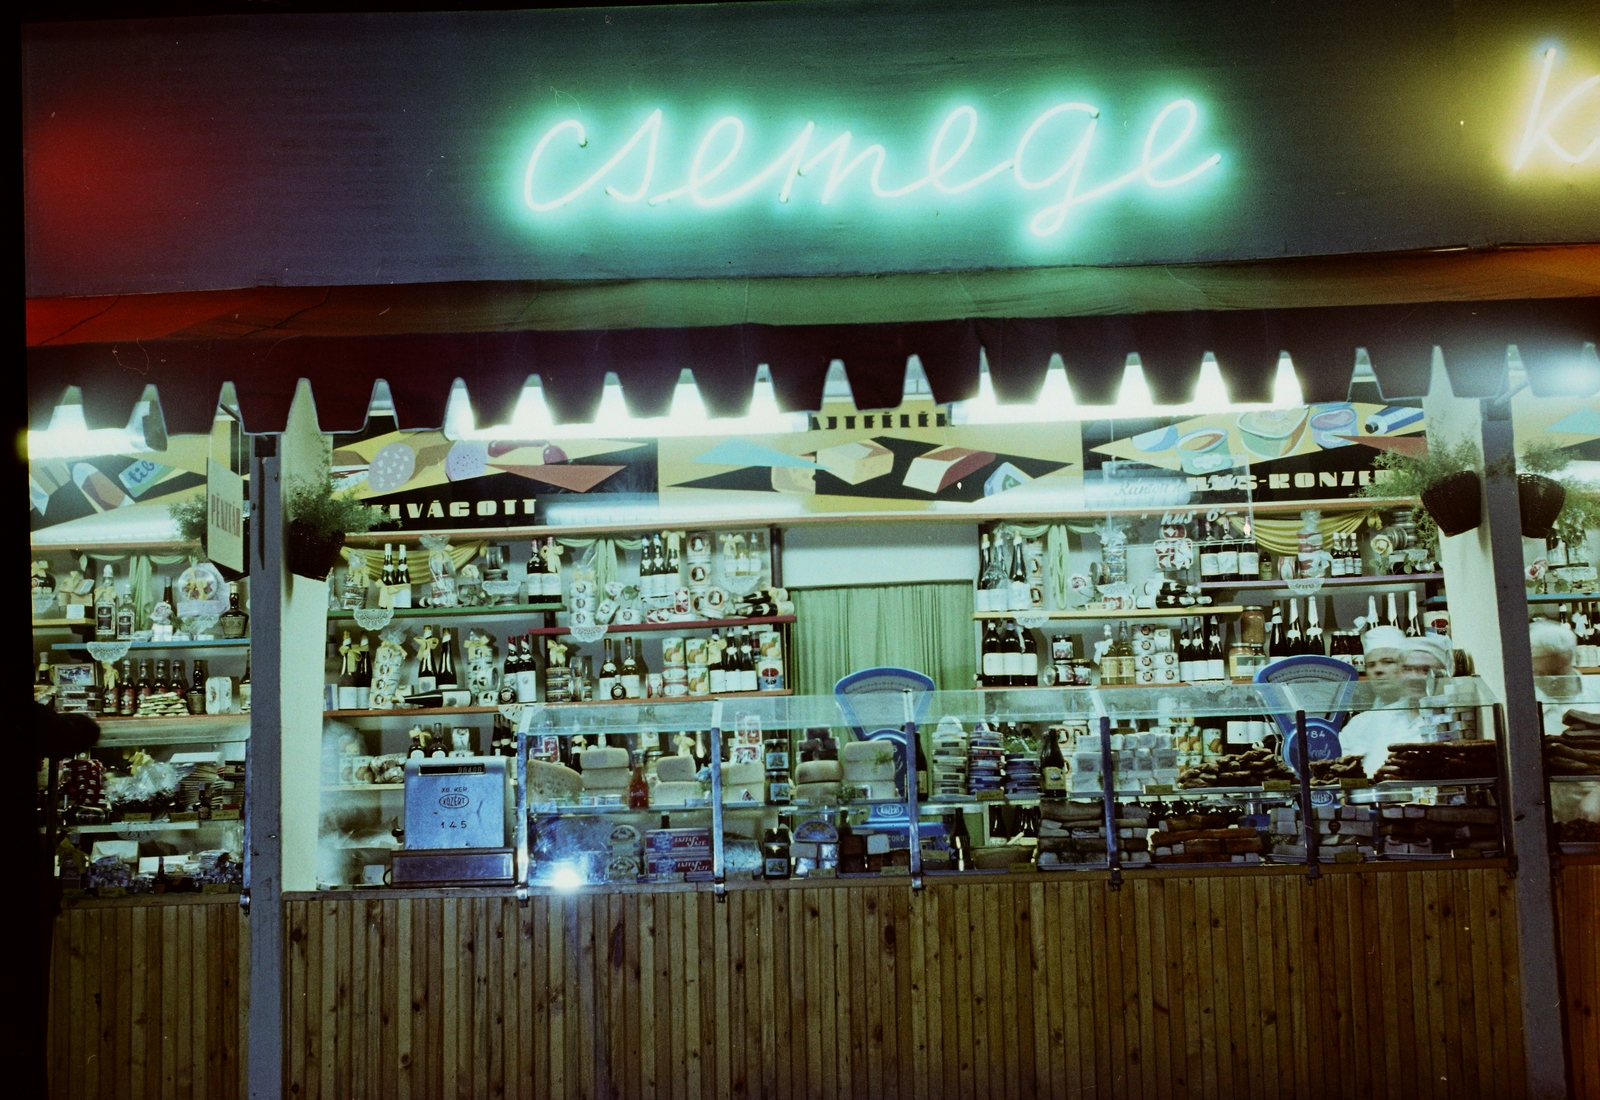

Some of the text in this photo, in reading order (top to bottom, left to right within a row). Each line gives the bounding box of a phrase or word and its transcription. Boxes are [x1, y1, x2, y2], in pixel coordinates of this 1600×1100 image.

[523, 98, 1221, 238] csemege
[812, 410, 956, 431] AJTFÉLÉK
[359, 498, 537, 520] LVÁGOTT
